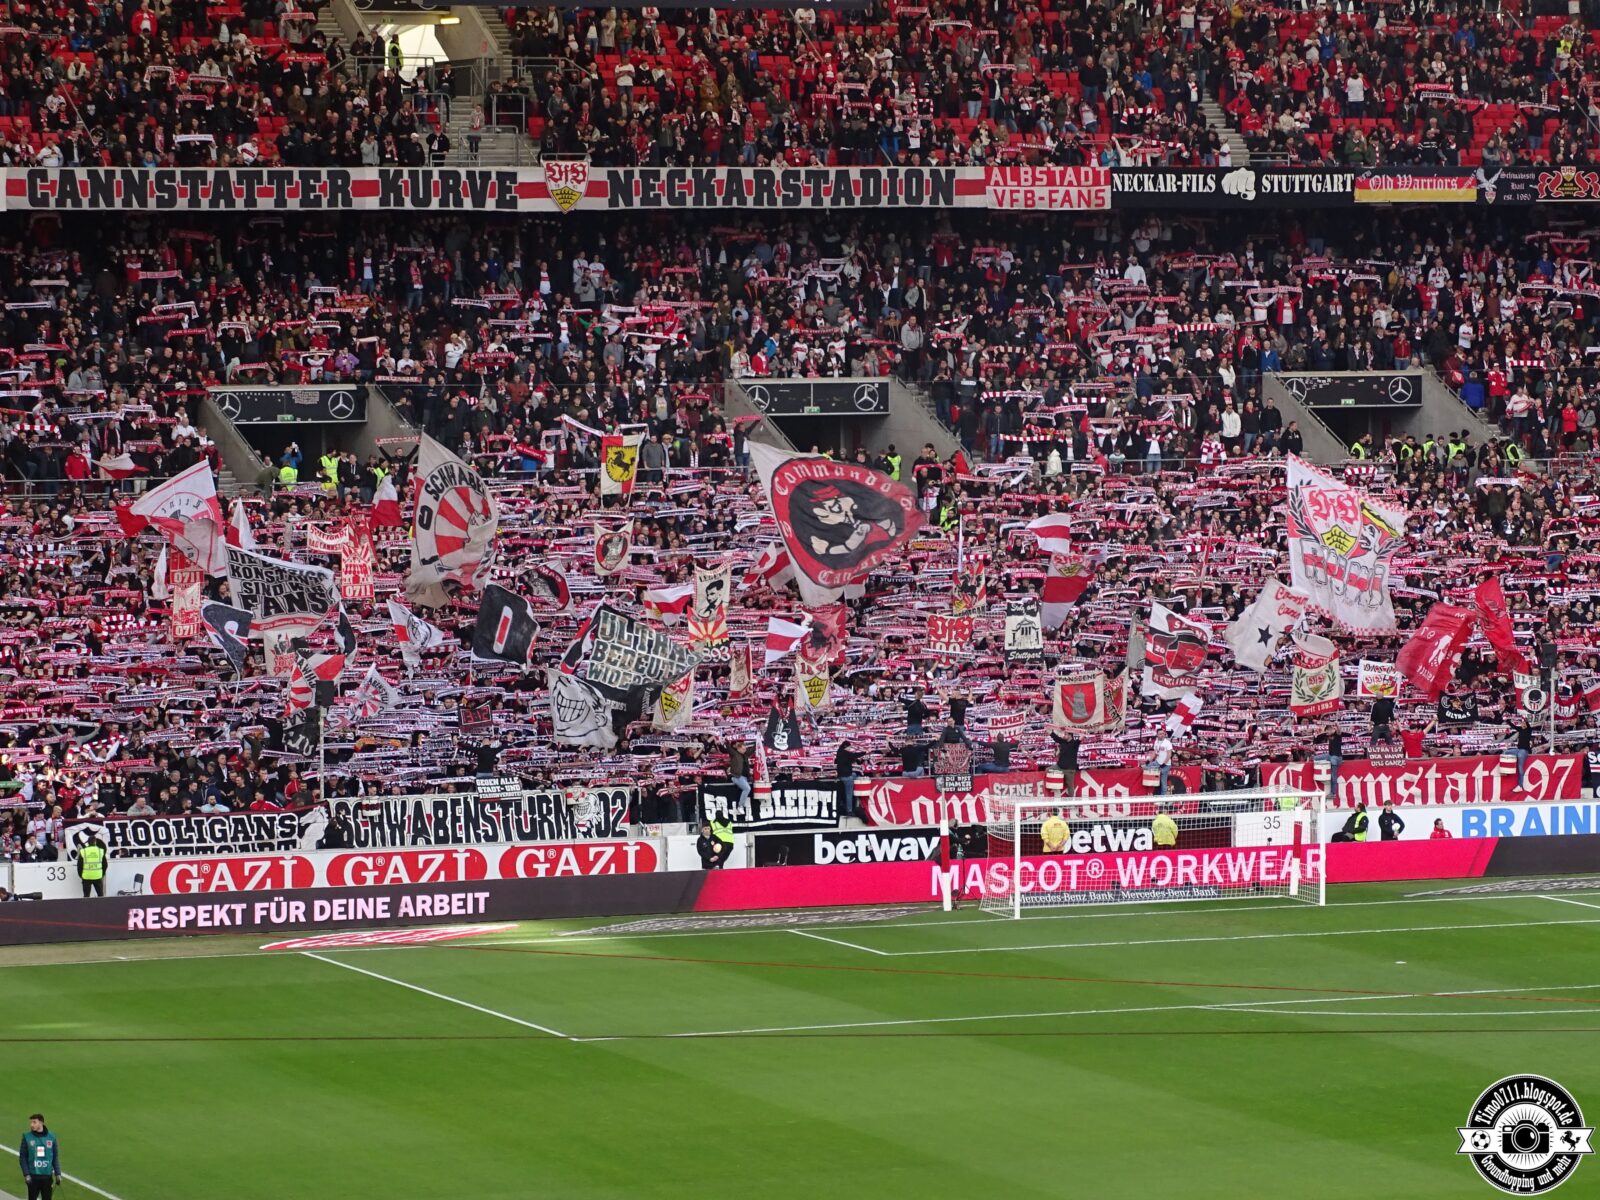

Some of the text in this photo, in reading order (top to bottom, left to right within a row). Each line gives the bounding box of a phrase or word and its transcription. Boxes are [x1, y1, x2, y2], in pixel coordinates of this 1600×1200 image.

[989, 166, 1107, 188] ALBSTADT
[1112, 172, 1216, 193] NECKAR-FILS
[1261, 172, 1355, 194] STUTTGART
[26, 168, 957, 209] CANNSTATTER KURVE NECKARSTADION
[995, 188, 1107, 209] VFB-FANS
[774, 463, 892, 496] Commando
[345, 584, 372, 597] 0711
[239, 591, 331, 618] FANS
[1007, 650, 1042, 663] Stuttgart
[991, 713, 1025, 726] IMMER
[476, 776, 519, 786] GEGEN ALLE
[505, 784, 521, 792] UND
[993, 782, 1032, 799] SZENE
[1522, 758, 1576, 802] 97
[759, 789, 838, 820] BLEIBT!
[332, 788, 630, 849] SCHWABENSTURM 02
[1262, 815, 1282, 831] 35
[1461, 805, 1600, 839] BRAIN
[105, 813, 299, 847] HOOLIGANS
[1063, 824, 1153, 854] etwa
[46, 866, 67, 882] 33
[1116, 847, 1328, 889] WORKWEAR
[1089, 890, 1114, 902] Bank
[1121, 886, 1218, 901] Mercedes-Benz Bank
[127, 891, 490, 931] RESPEKT FÜR DEINE ARBEIT
